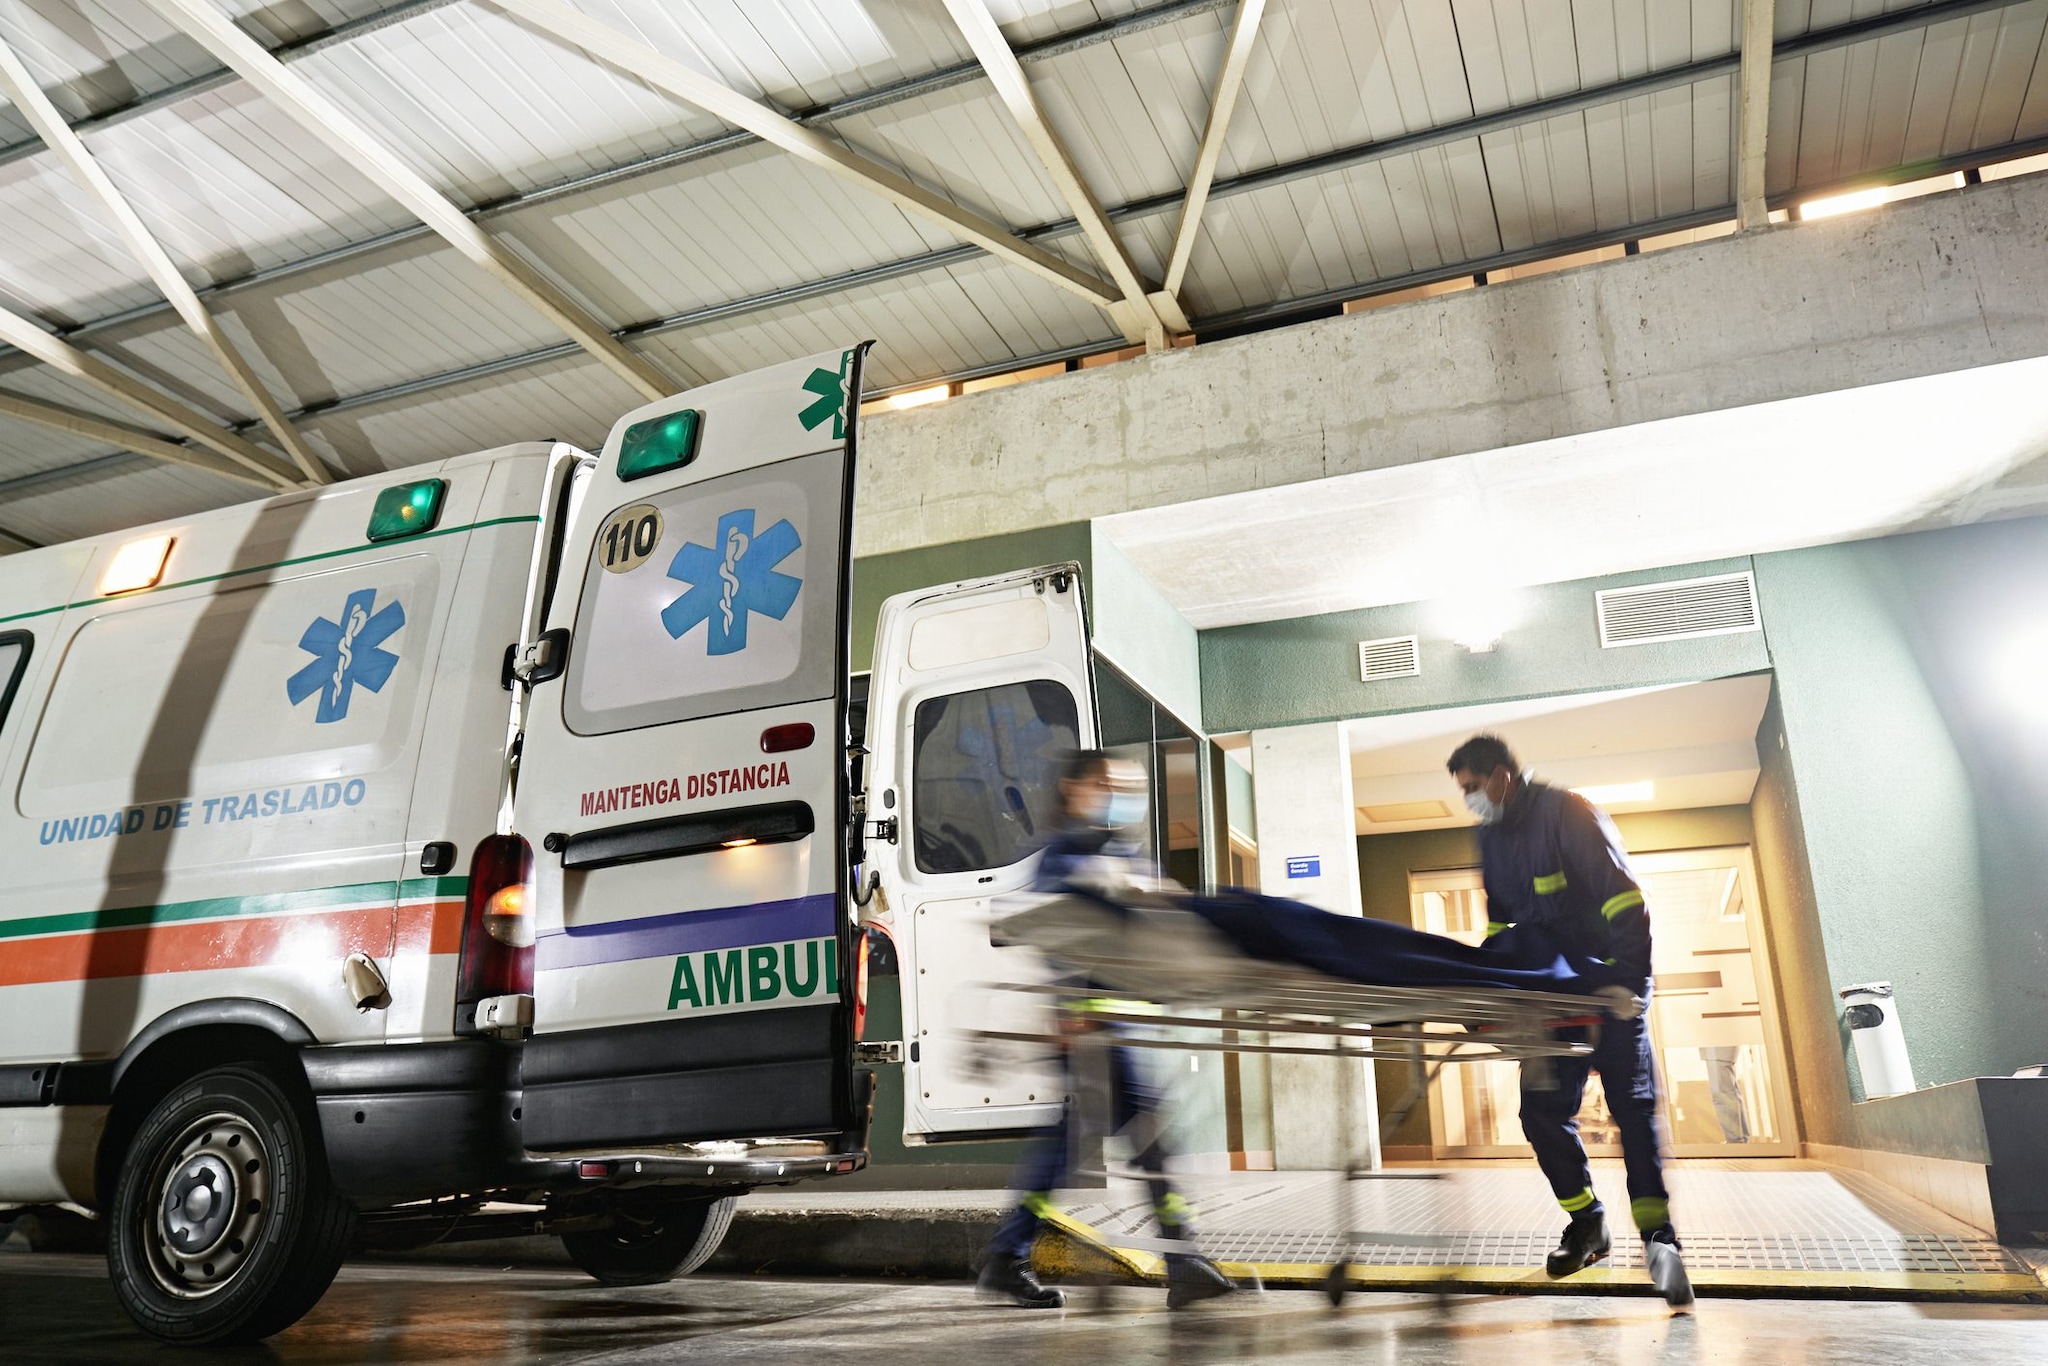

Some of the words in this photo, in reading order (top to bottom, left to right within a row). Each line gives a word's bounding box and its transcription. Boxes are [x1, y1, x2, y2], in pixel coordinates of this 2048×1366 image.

[606, 514, 657, 566] 110
[40, 804, 144, 846] UNIDAD
[152, 801, 193, 832] DE
[202, 778, 366, 825] TRASLADO
[581, 778, 681, 817] MANTENGA
[687, 761, 790, 800] DISTANCIA
